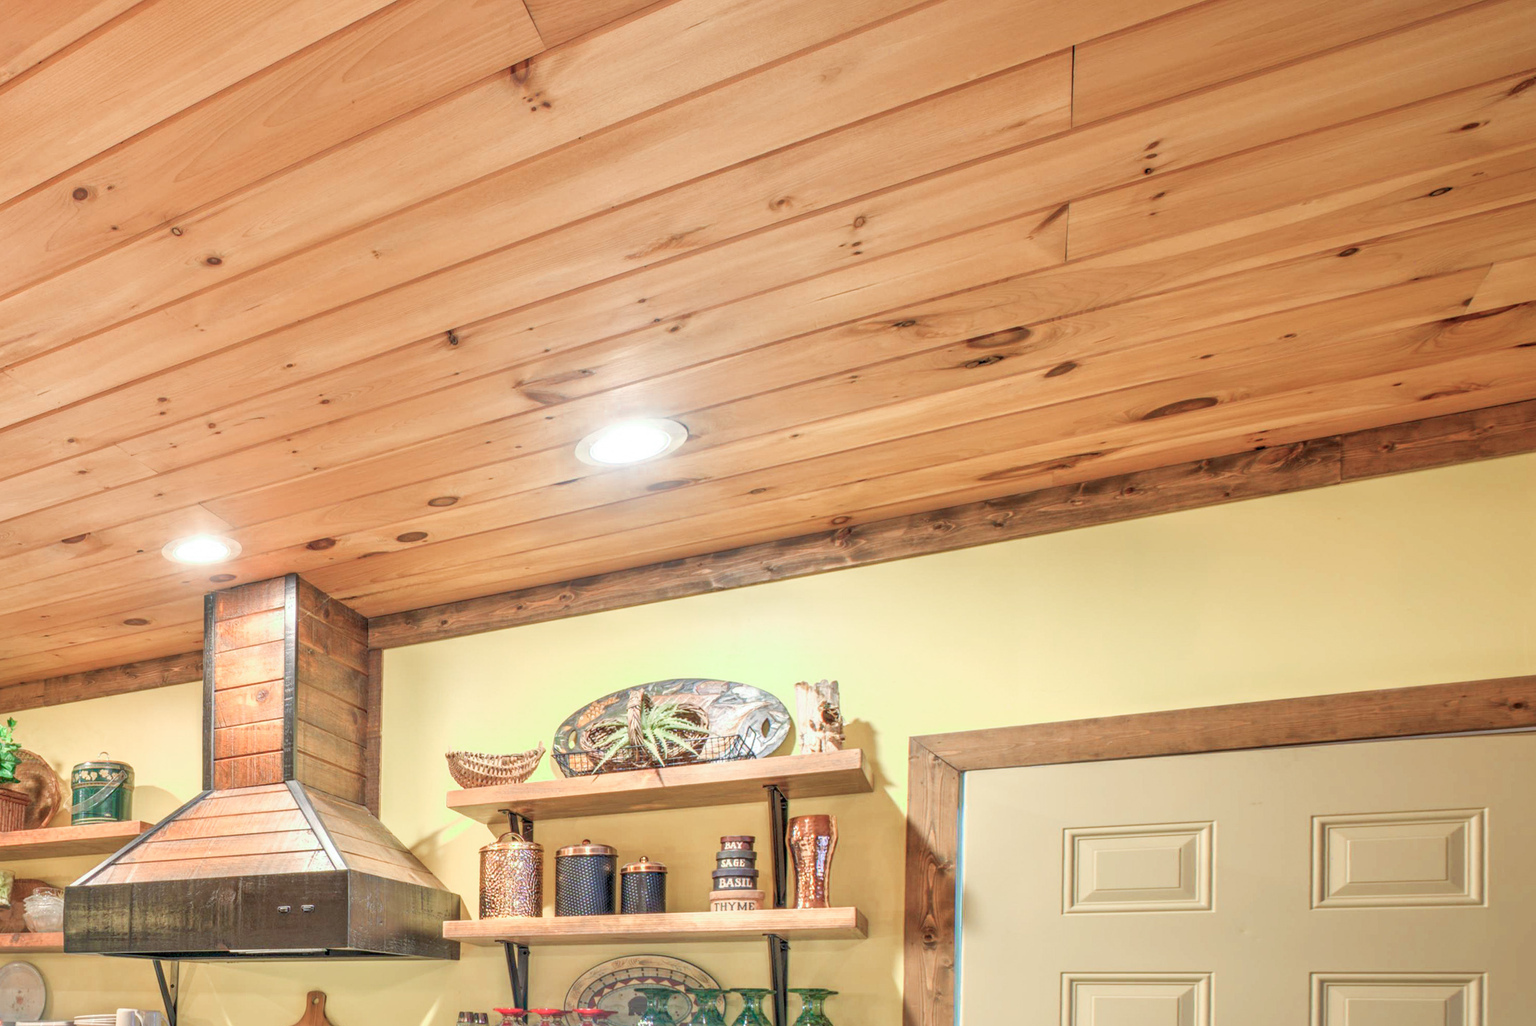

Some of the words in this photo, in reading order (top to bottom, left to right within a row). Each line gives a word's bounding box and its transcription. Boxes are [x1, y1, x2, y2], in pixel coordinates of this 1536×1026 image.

[724, 841, 743, 850] BAY
[720, 858, 746, 867] SAGE
[718, 877, 752, 888] BASIL
[714, 901, 755, 911] THYME
